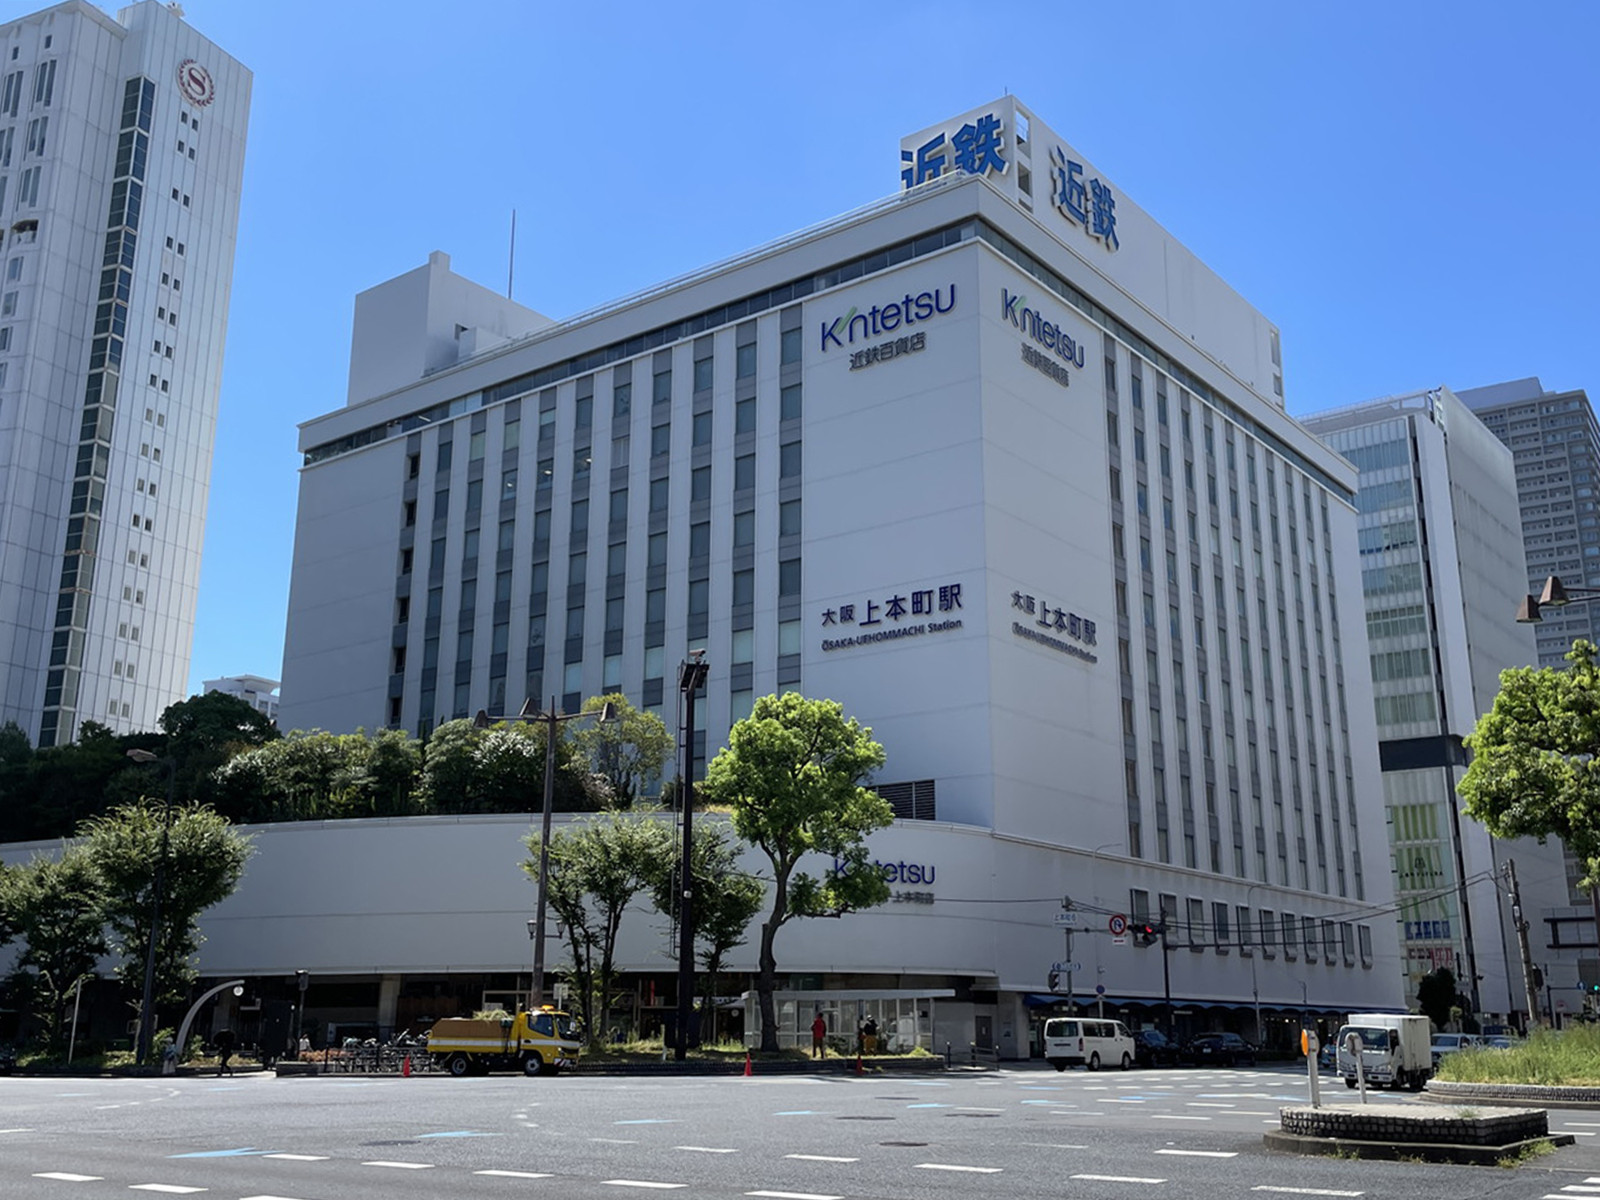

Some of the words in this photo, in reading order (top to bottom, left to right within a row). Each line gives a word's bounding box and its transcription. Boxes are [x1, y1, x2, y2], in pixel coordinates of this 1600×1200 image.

[901, 113, 1009, 189] 近鉄
[1051, 145, 1120, 251] 近鉄
[927, 619, 963, 634] Station
